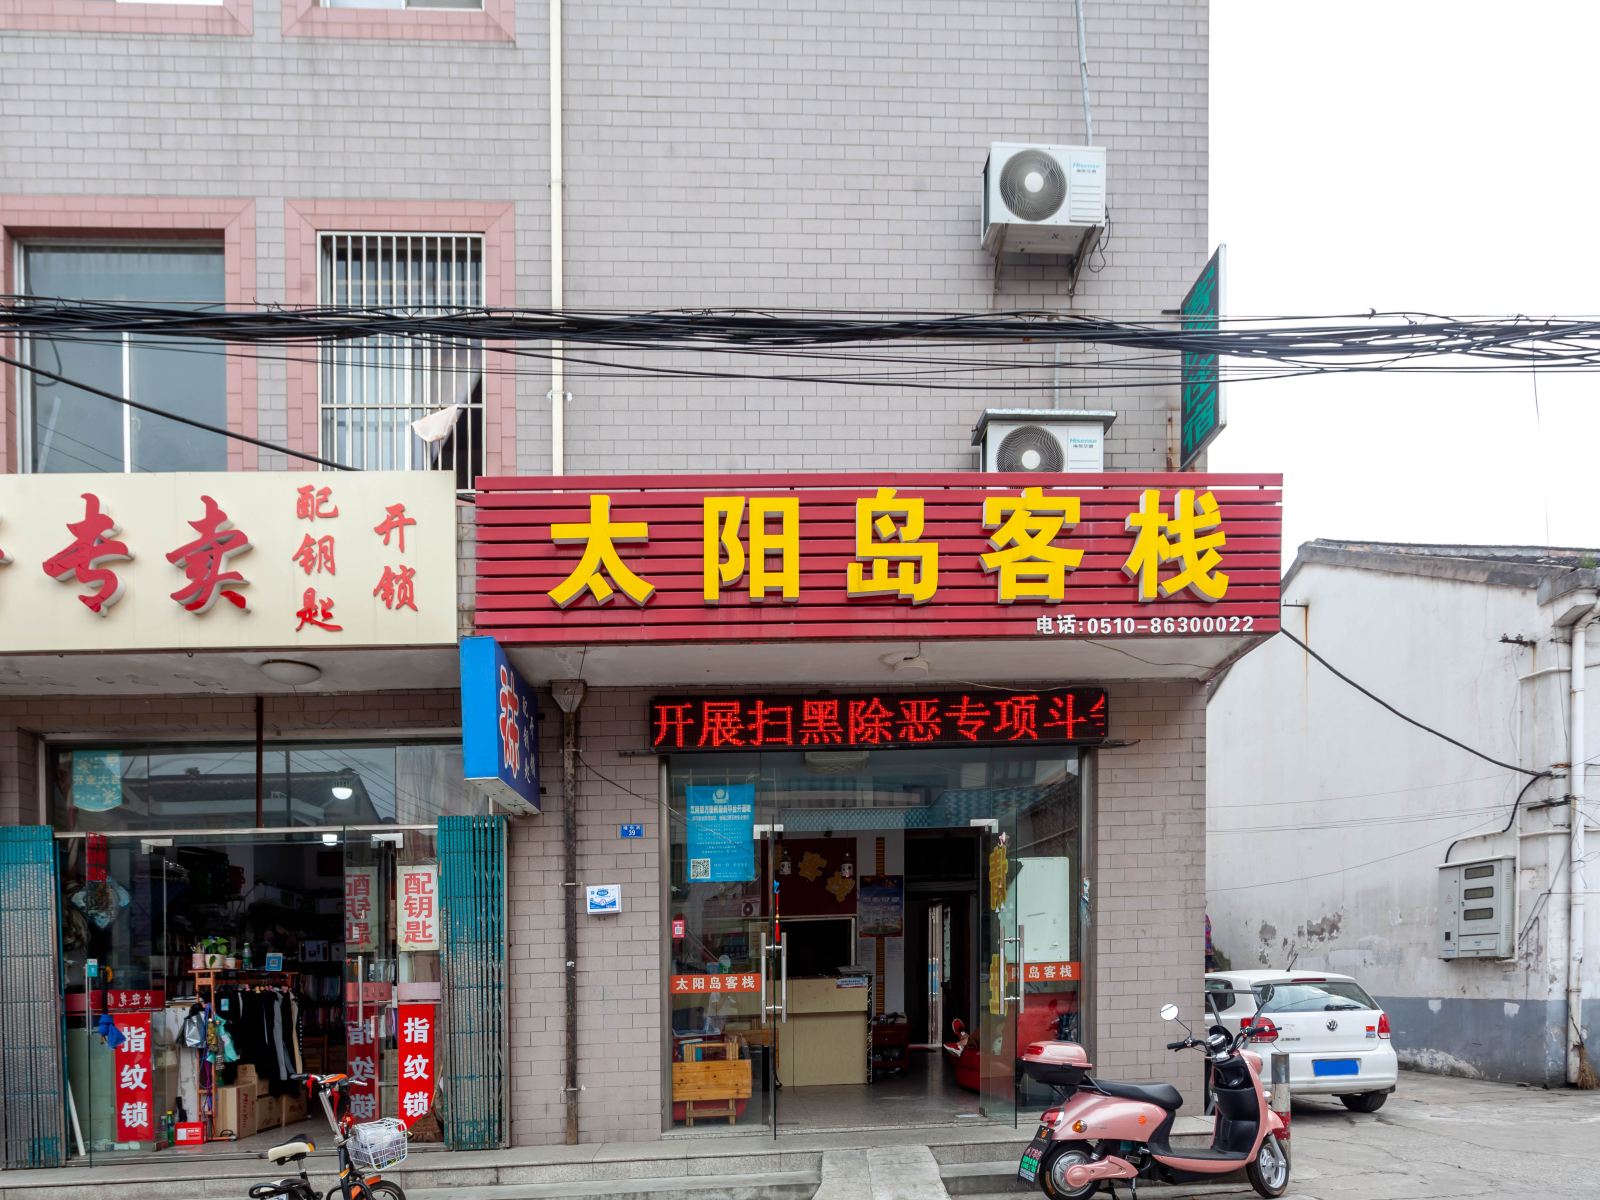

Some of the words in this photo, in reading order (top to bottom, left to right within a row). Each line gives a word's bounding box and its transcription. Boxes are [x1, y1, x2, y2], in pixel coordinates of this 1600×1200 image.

[0, 493, 255, 616] 专卖
[292, 484, 344, 632] 配钥匙
[373, 503, 418, 612] 开锁
[547, 487, 1229, 609] 太阳岛客栈
[403, 872, 434, 944] 配钥匙
[675, 975, 755, 991] 太阳岛客栈
[120, 1026, 149, 1129] 指纹锁
[403, 1017, 430, 1117] 指纹锁
